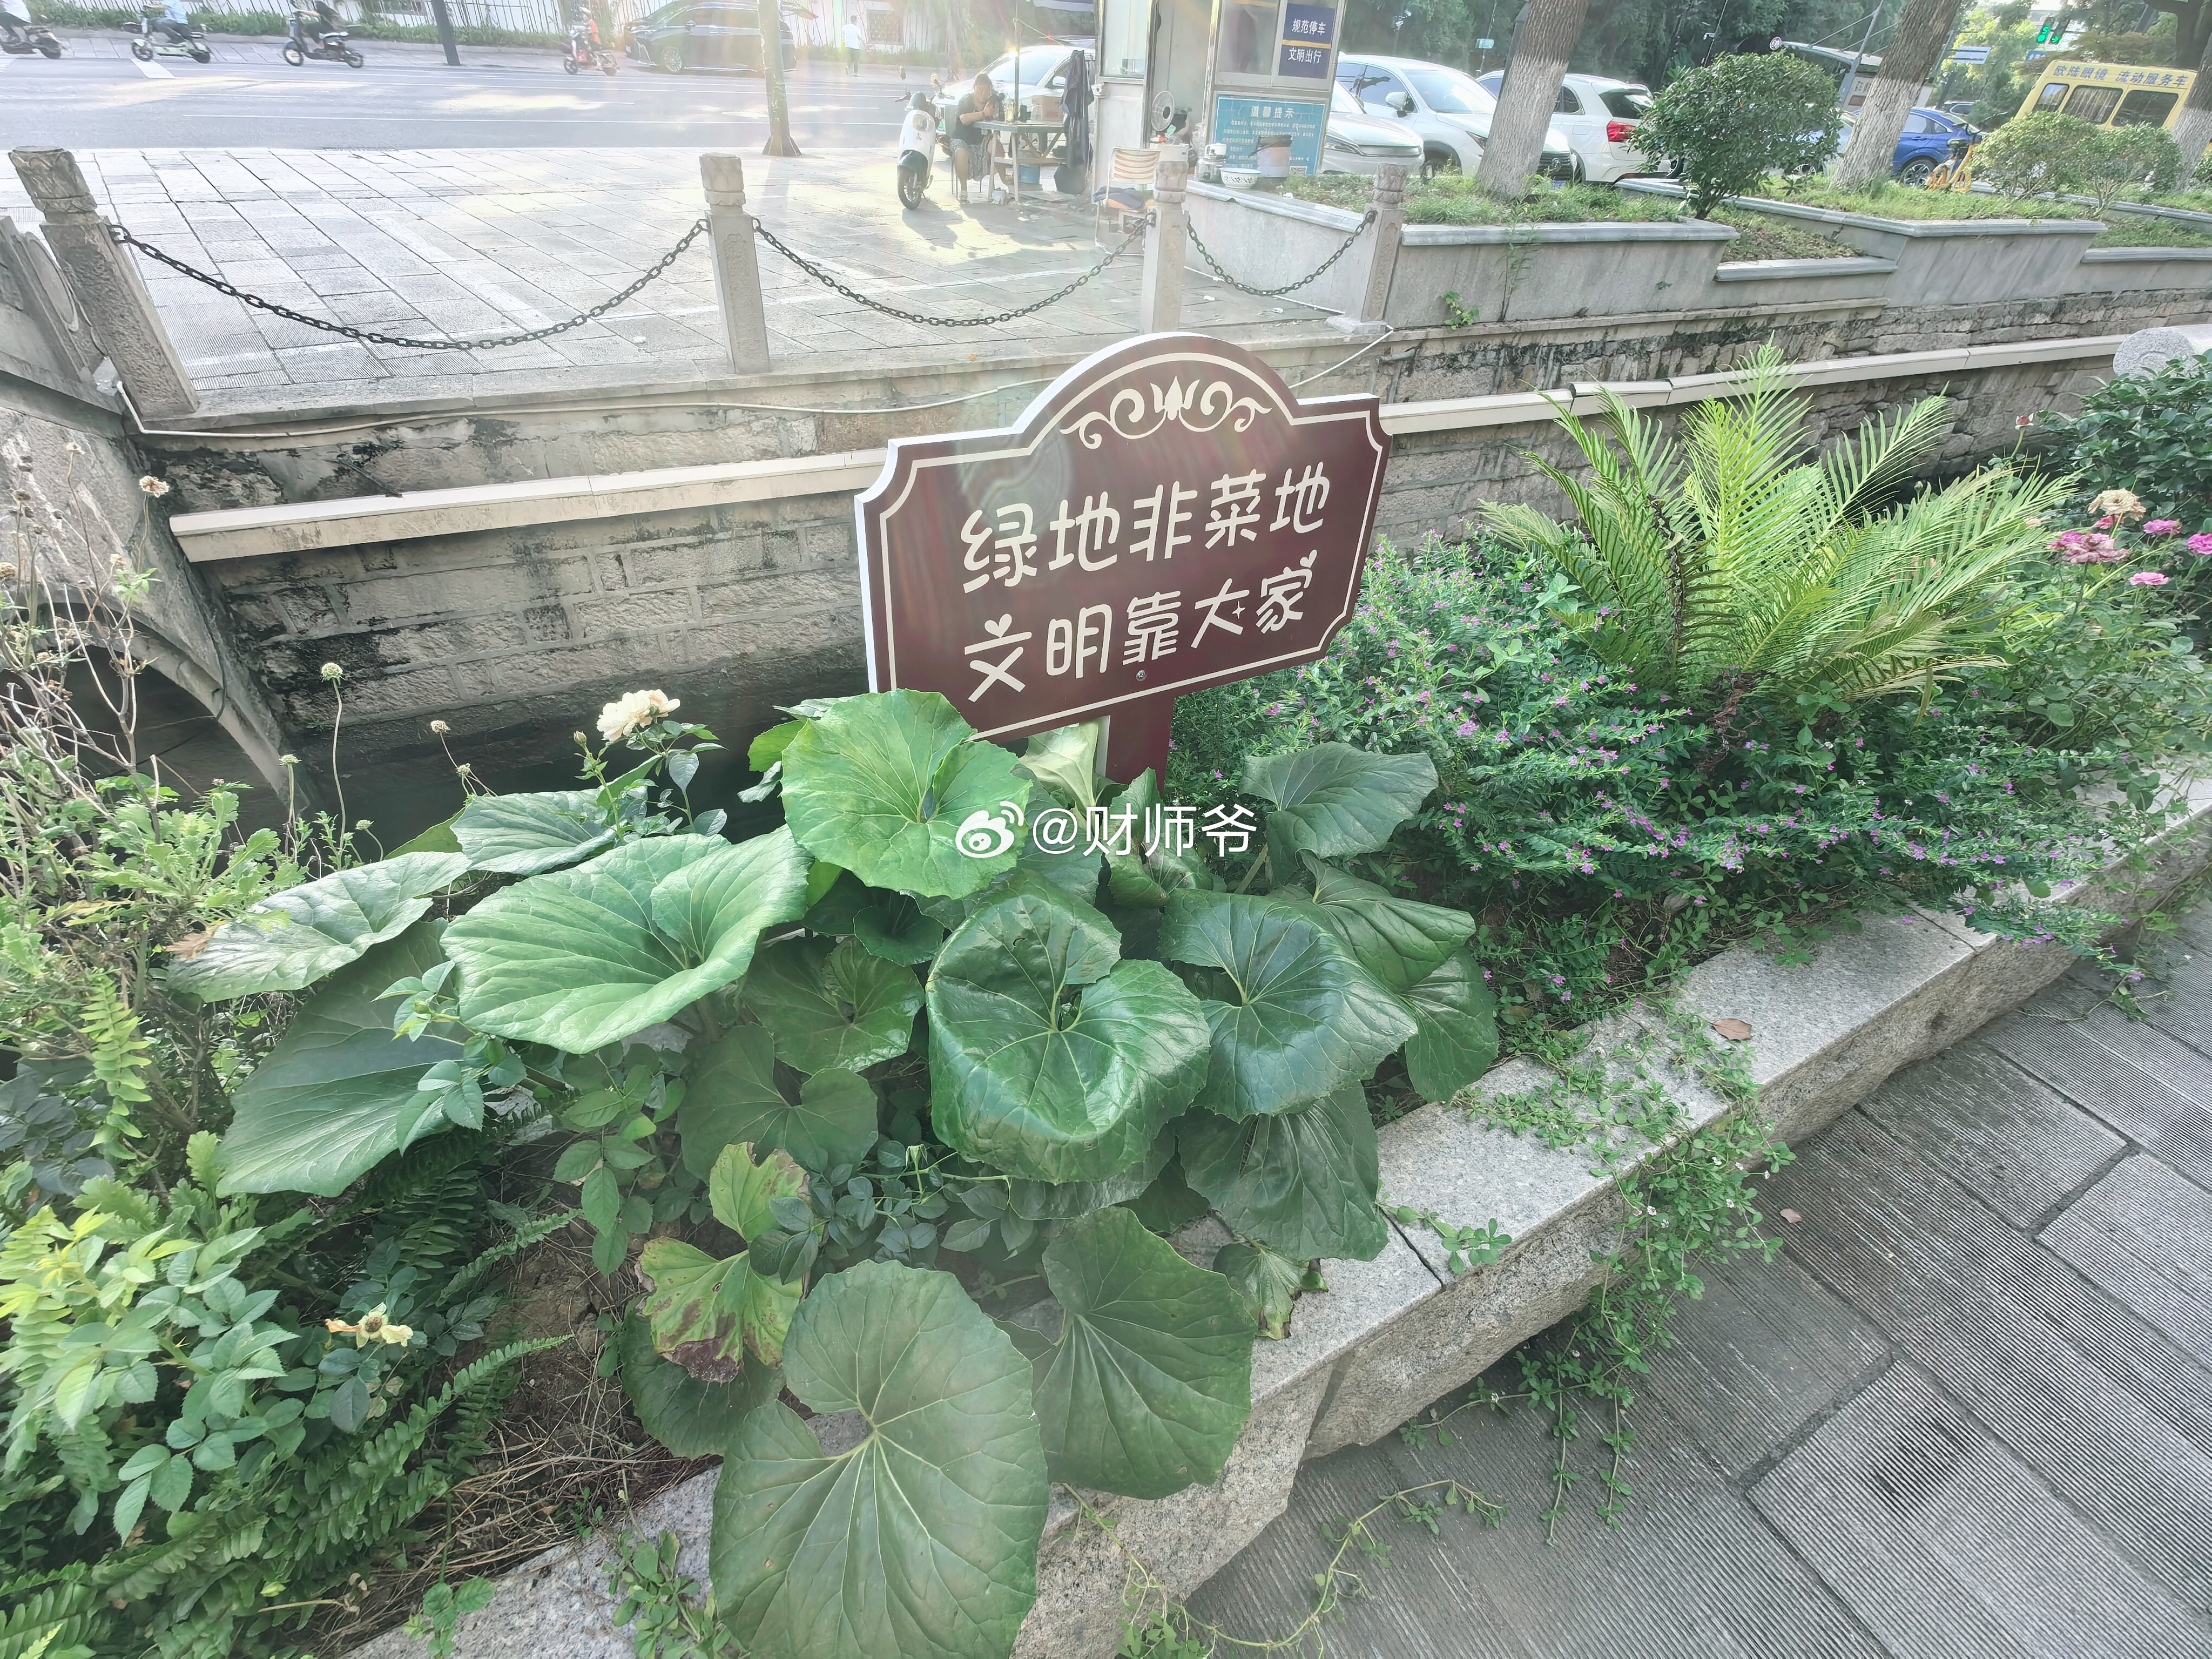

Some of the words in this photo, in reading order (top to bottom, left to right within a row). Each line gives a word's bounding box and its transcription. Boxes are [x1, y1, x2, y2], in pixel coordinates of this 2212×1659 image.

[1291, 18, 1326, 36] 规范停车
[1287, 46, 1322, 64] 文明出行
[2053, 65, 2108, 80] 欧陆眼镜
[2115, 71, 2189, 87] 流动服务车
[960, 461, 1330, 594] 绿地非菜地
[963, 550, 1318, 703] 文明靠大家
